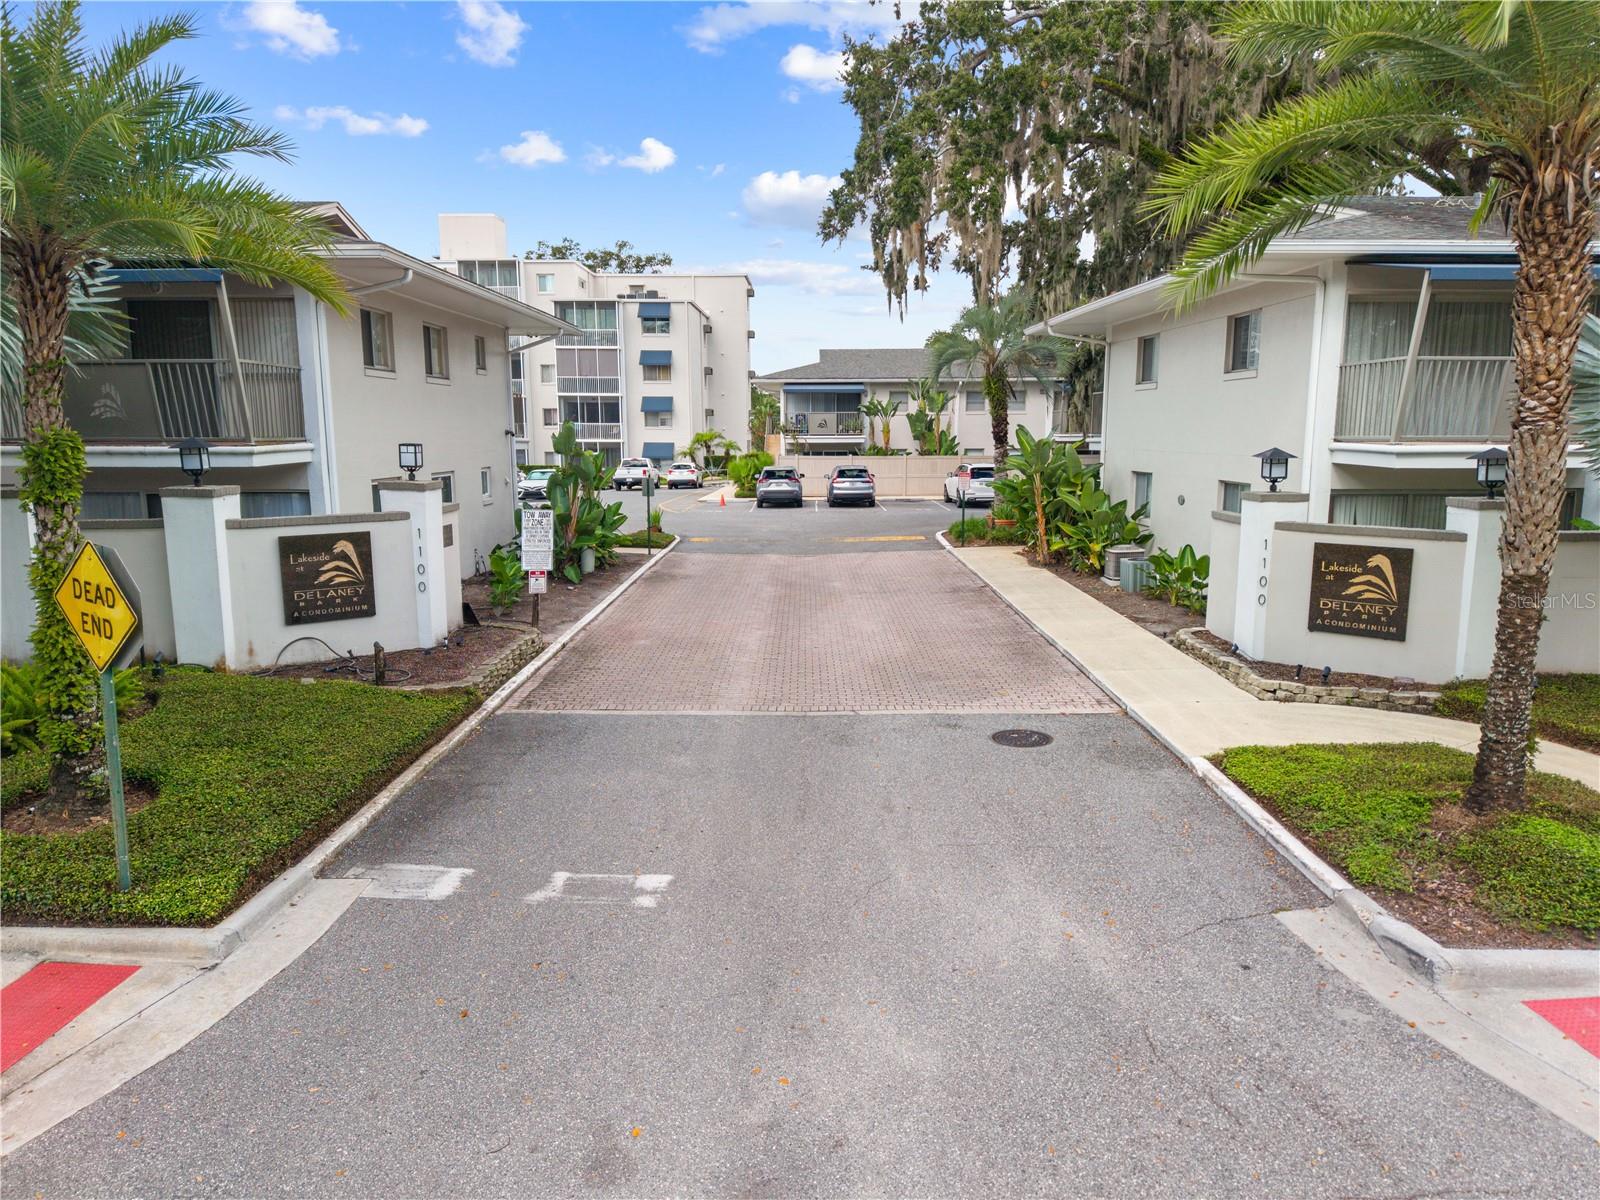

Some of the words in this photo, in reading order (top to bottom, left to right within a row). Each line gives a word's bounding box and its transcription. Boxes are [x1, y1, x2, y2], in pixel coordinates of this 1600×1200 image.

[524, 511, 535, 519] TOW
[538, 511, 551, 519] AWAY
[531, 519, 544, 527] ZONE
[290, 552, 330, 565] Lakeside
[417, 527, 427, 593] 1100
[1257, 538, 1268, 606] 1100
[1321, 560, 1363, 573] Lakeside
[72, 578, 116, 609] DEAD
[294, 588, 364, 601] DELANEY
[302, 604, 368, 617] CONDOMINIUM
[1319, 600, 1398, 616] DELANEY
[1323, 611, 1388, 622] PARK
[81, 612, 113, 640] END
[1324, 619, 1397, 633] CONDOMINIUM
